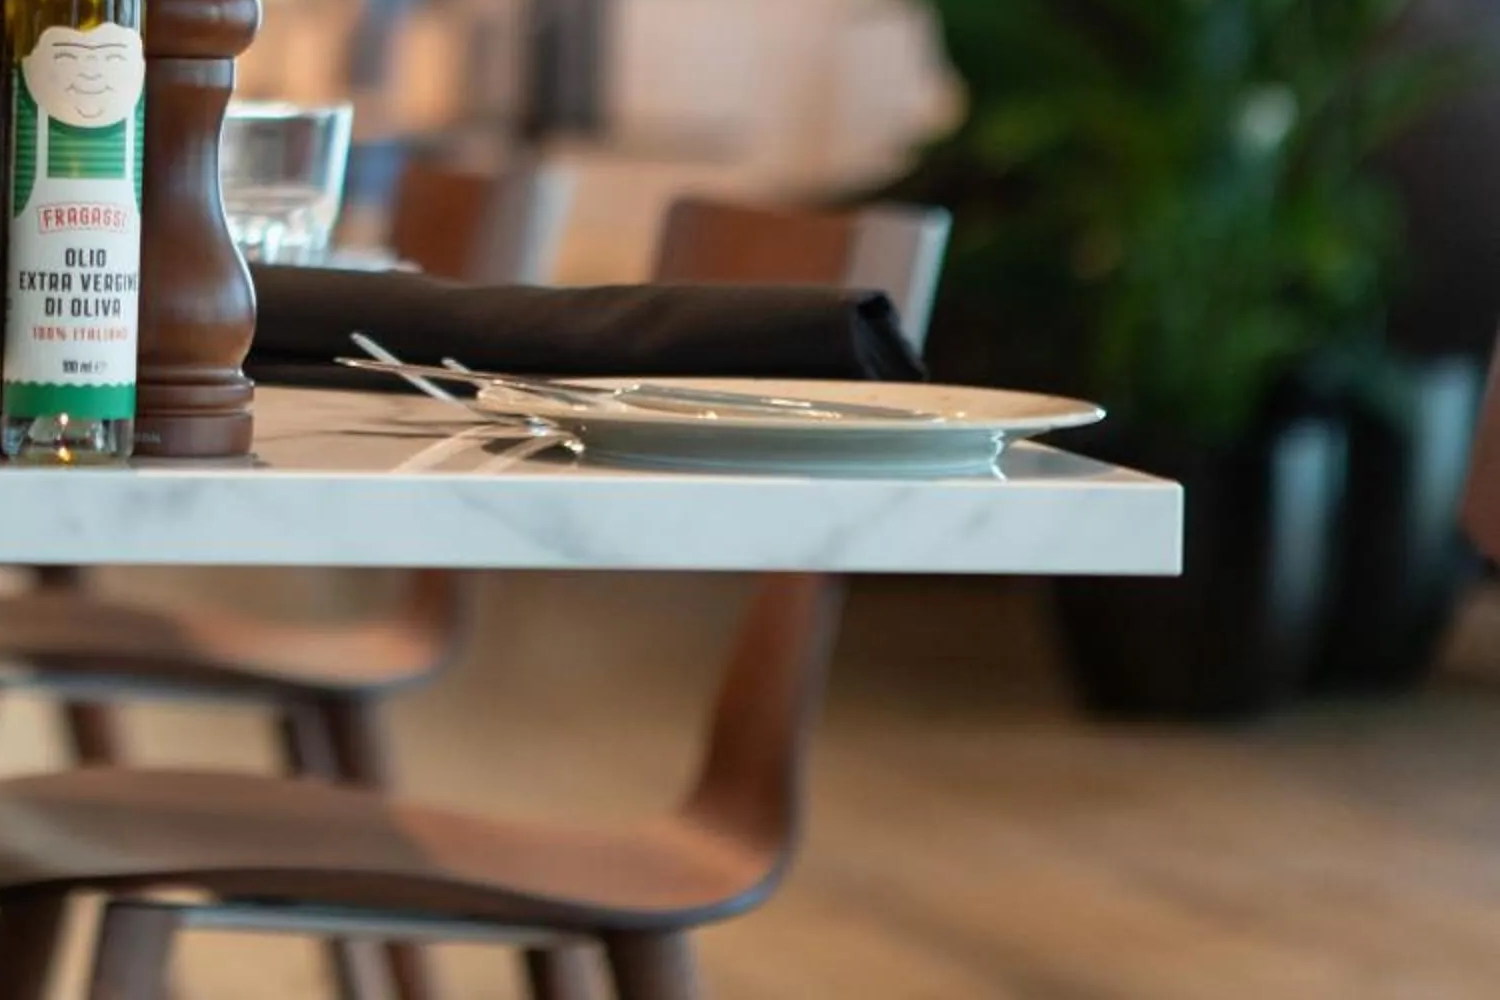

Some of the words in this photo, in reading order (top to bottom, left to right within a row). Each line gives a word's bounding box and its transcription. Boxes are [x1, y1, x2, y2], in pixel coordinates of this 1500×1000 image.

[65, 248, 107, 268] OLIO
[19, 271, 72, 292] EXTRA
[45, 297, 62, 317] DI
[71, 297, 121, 318] OLIVA
[32, 326, 68, 341] 100%
